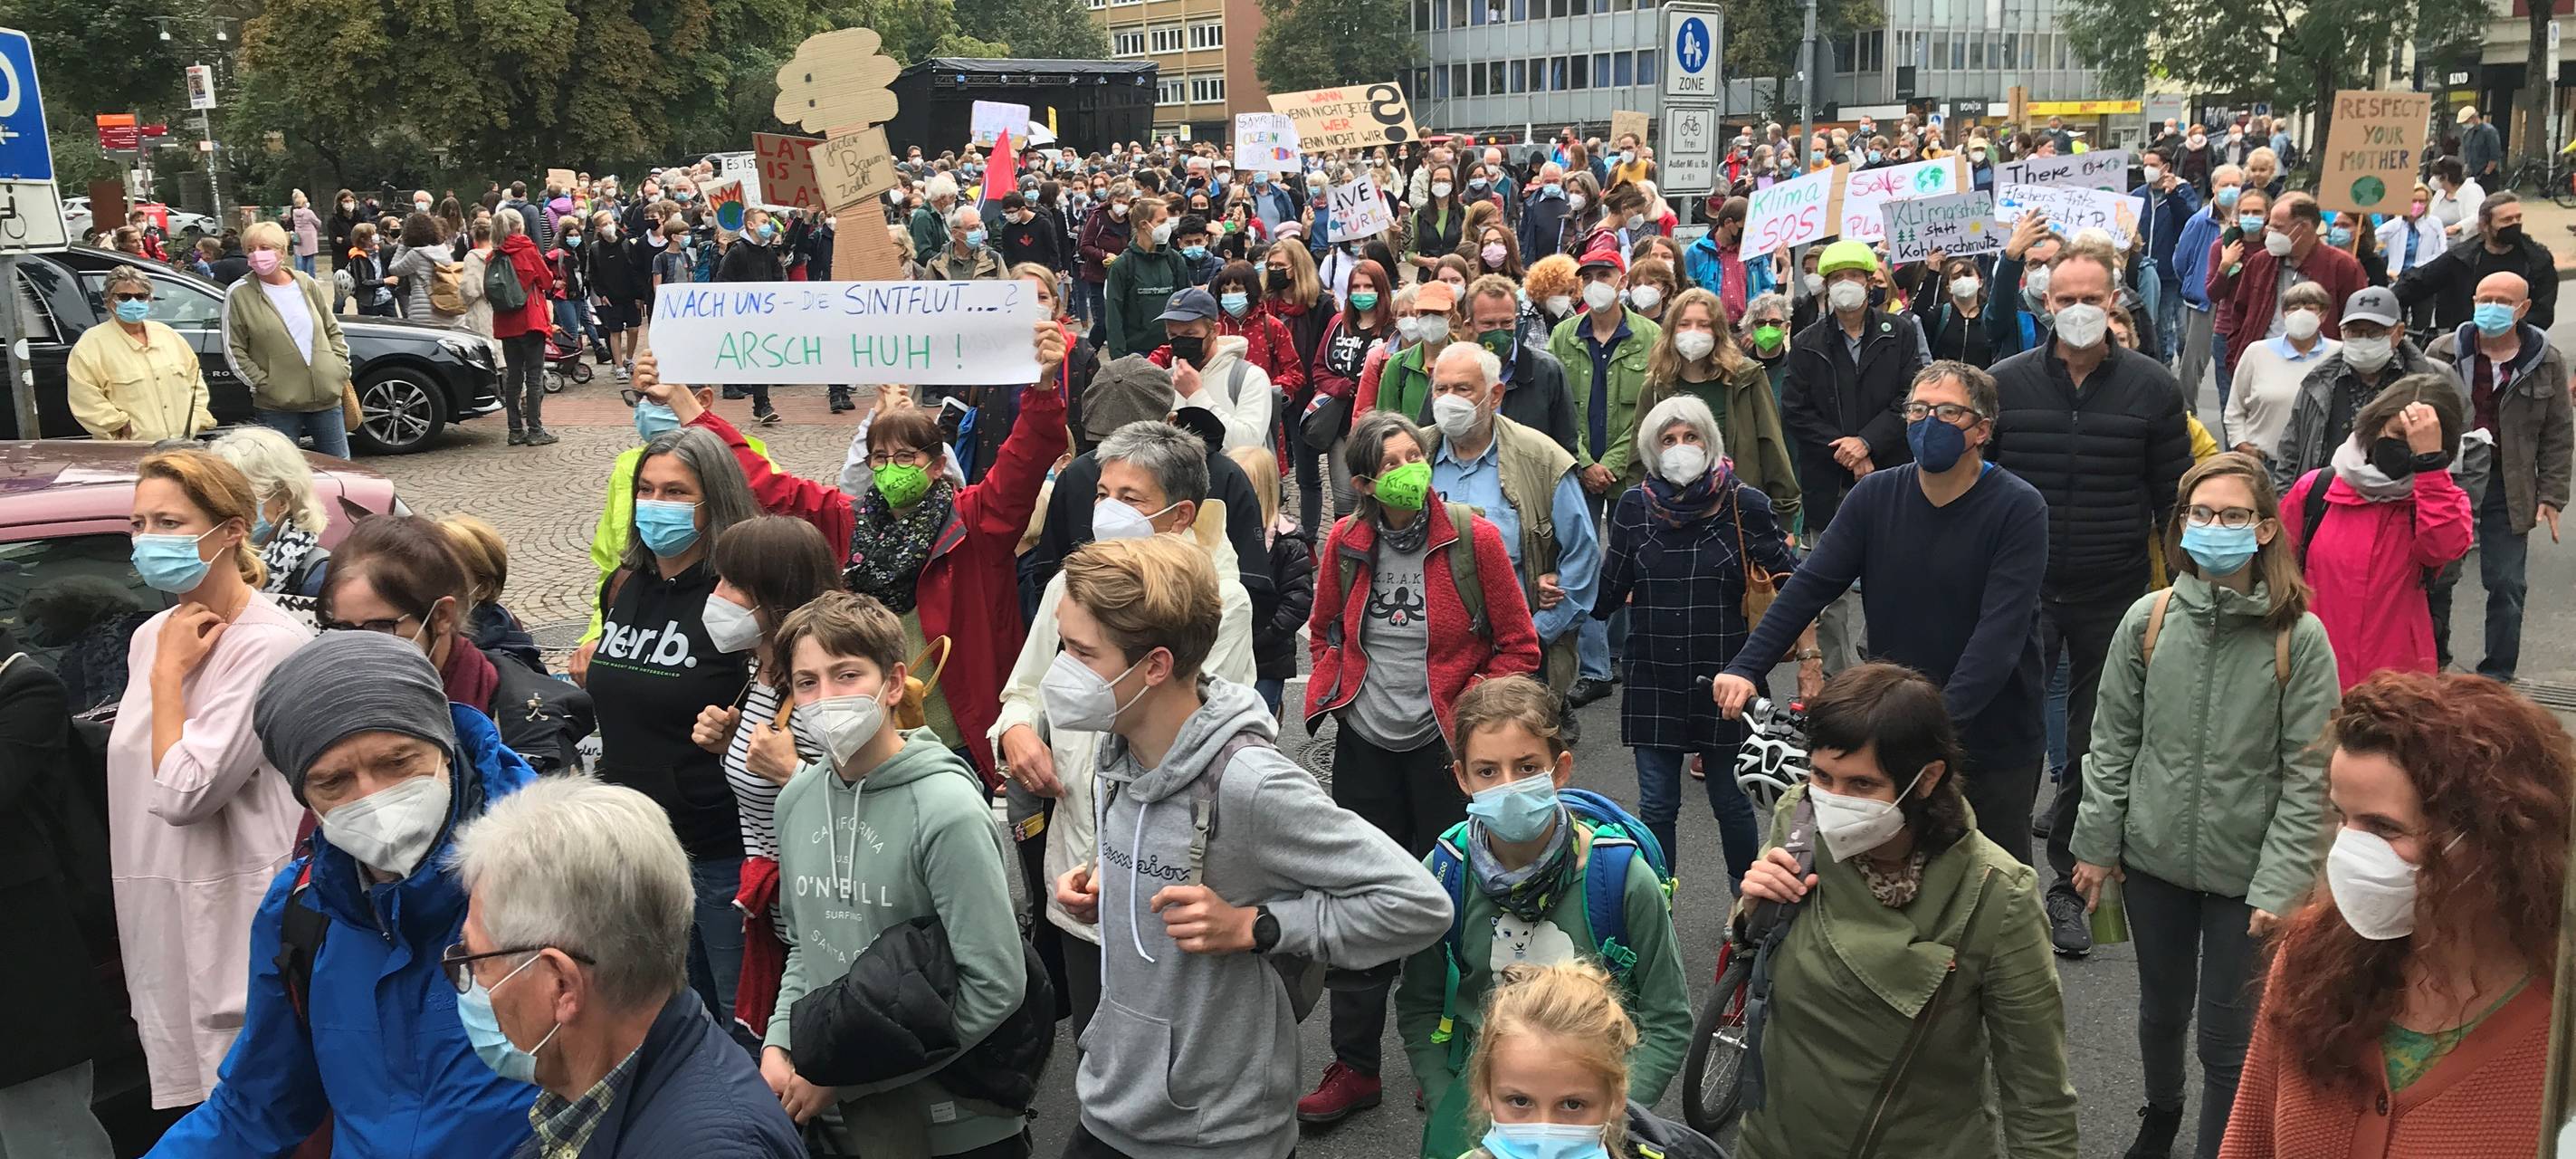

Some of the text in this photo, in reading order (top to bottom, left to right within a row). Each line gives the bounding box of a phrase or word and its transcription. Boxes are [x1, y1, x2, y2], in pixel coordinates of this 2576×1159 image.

[1679, 77, 1704, 91] ZONE
[1306, 91, 1343, 103] WANN
[1312, 104, 1343, 117] NICHT
[2340, 98, 2426, 120] RESPECT
[1321, 119, 1351, 131] WER
[2363, 125, 2404, 144] YOUR
[1326, 132, 1356, 146] NICHT
[1360, 130, 1384, 141] WIR
[1684, 139, 1696, 148] frei
[727, 158, 739, 169] ES
[768, 162, 789, 180] IS
[840, 150, 885, 177] Baum
[1668, 159, 1685, 168] Außer
[2339, 149, 2409, 172] MOTHER
[1852, 169, 1907, 196] Save
[2006, 163, 2073, 184] There
[1751, 181, 1824, 220] Klima
[1759, 206, 1818, 252] SOS
[662, 290, 724, 321] NACH
[735, 290, 775, 315] UNS
[714, 330, 821, 370] ARSCH
[852, 332, 930, 369] HUH
[1384, 475, 1419, 493] Klima
[812, 817, 884, 854] CAIFORNIA
[796, 876, 893, 907] O'NEILL
[811, 929, 846, 963] SANTA
